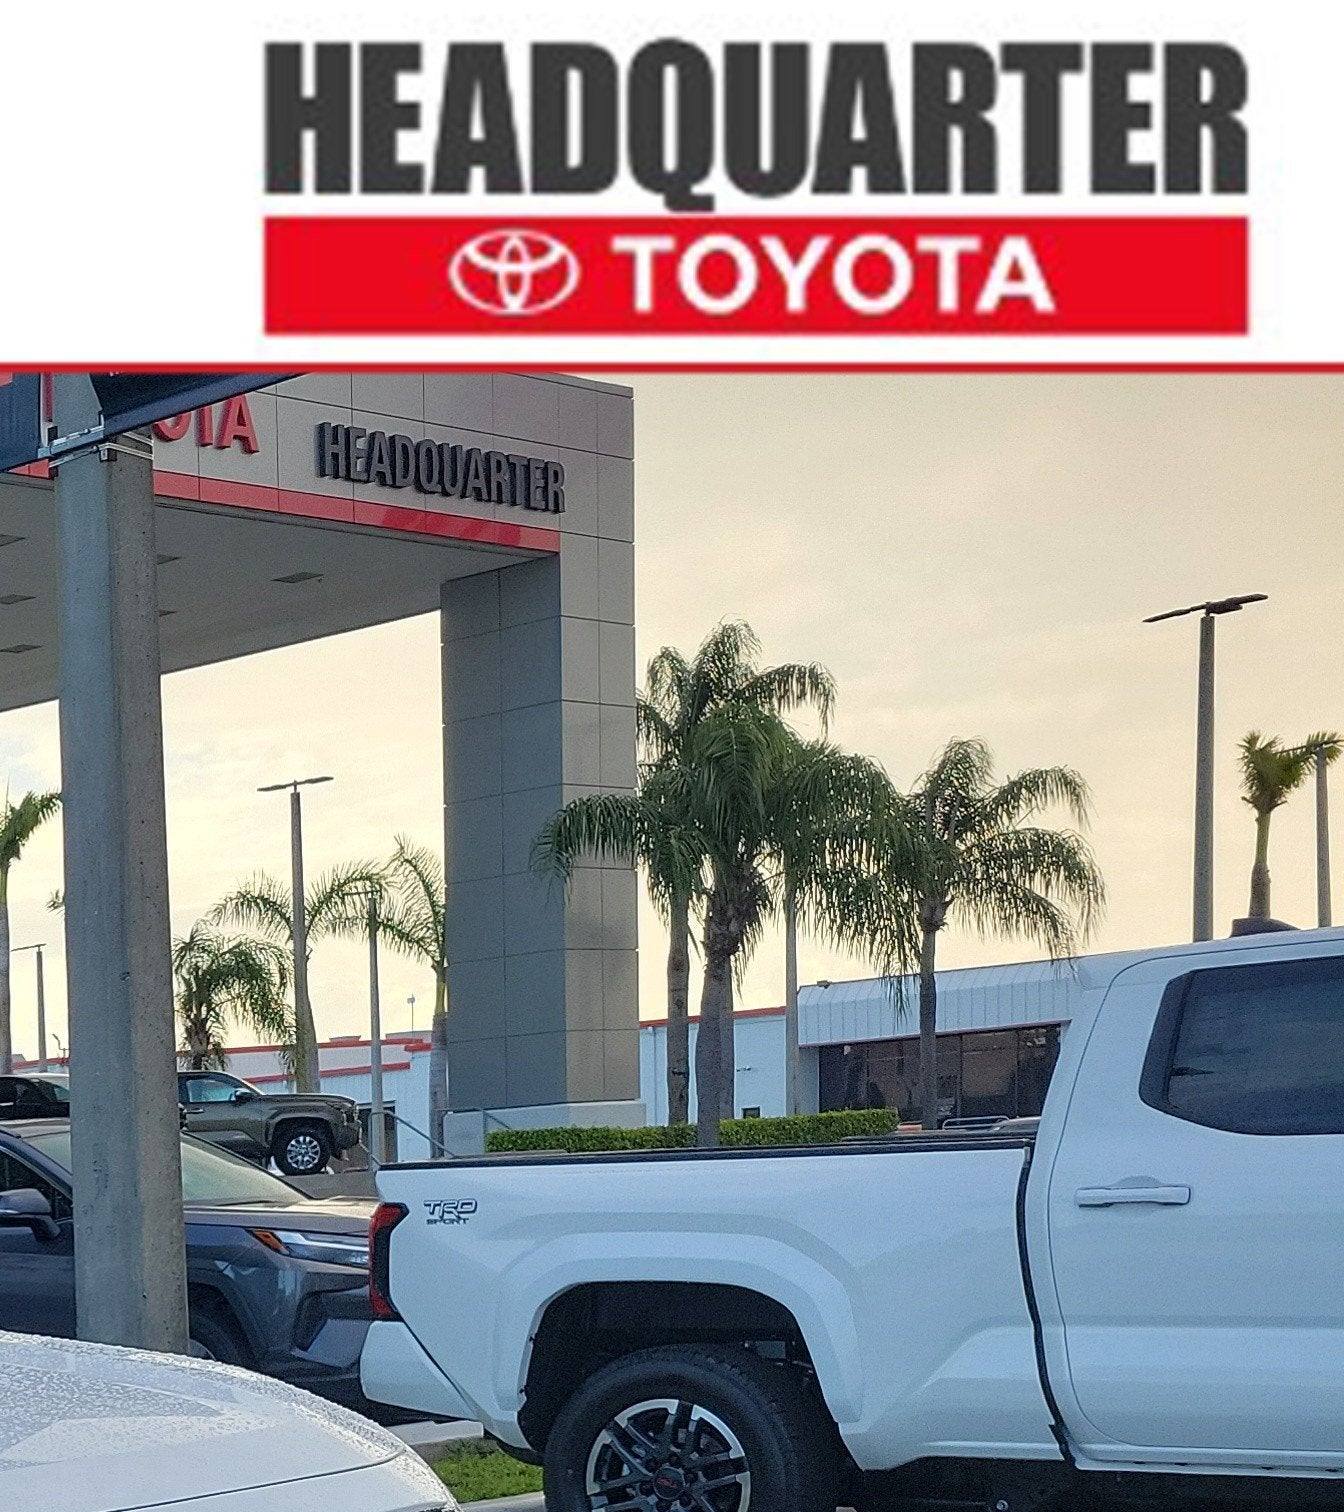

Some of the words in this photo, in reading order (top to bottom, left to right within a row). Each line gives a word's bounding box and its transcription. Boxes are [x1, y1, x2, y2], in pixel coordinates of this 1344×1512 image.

[315, 421, 565, 513] HEADQUARTER
[423, 1198, 478, 1220] TRD
[426, 1216, 470, 1225] SPORT
